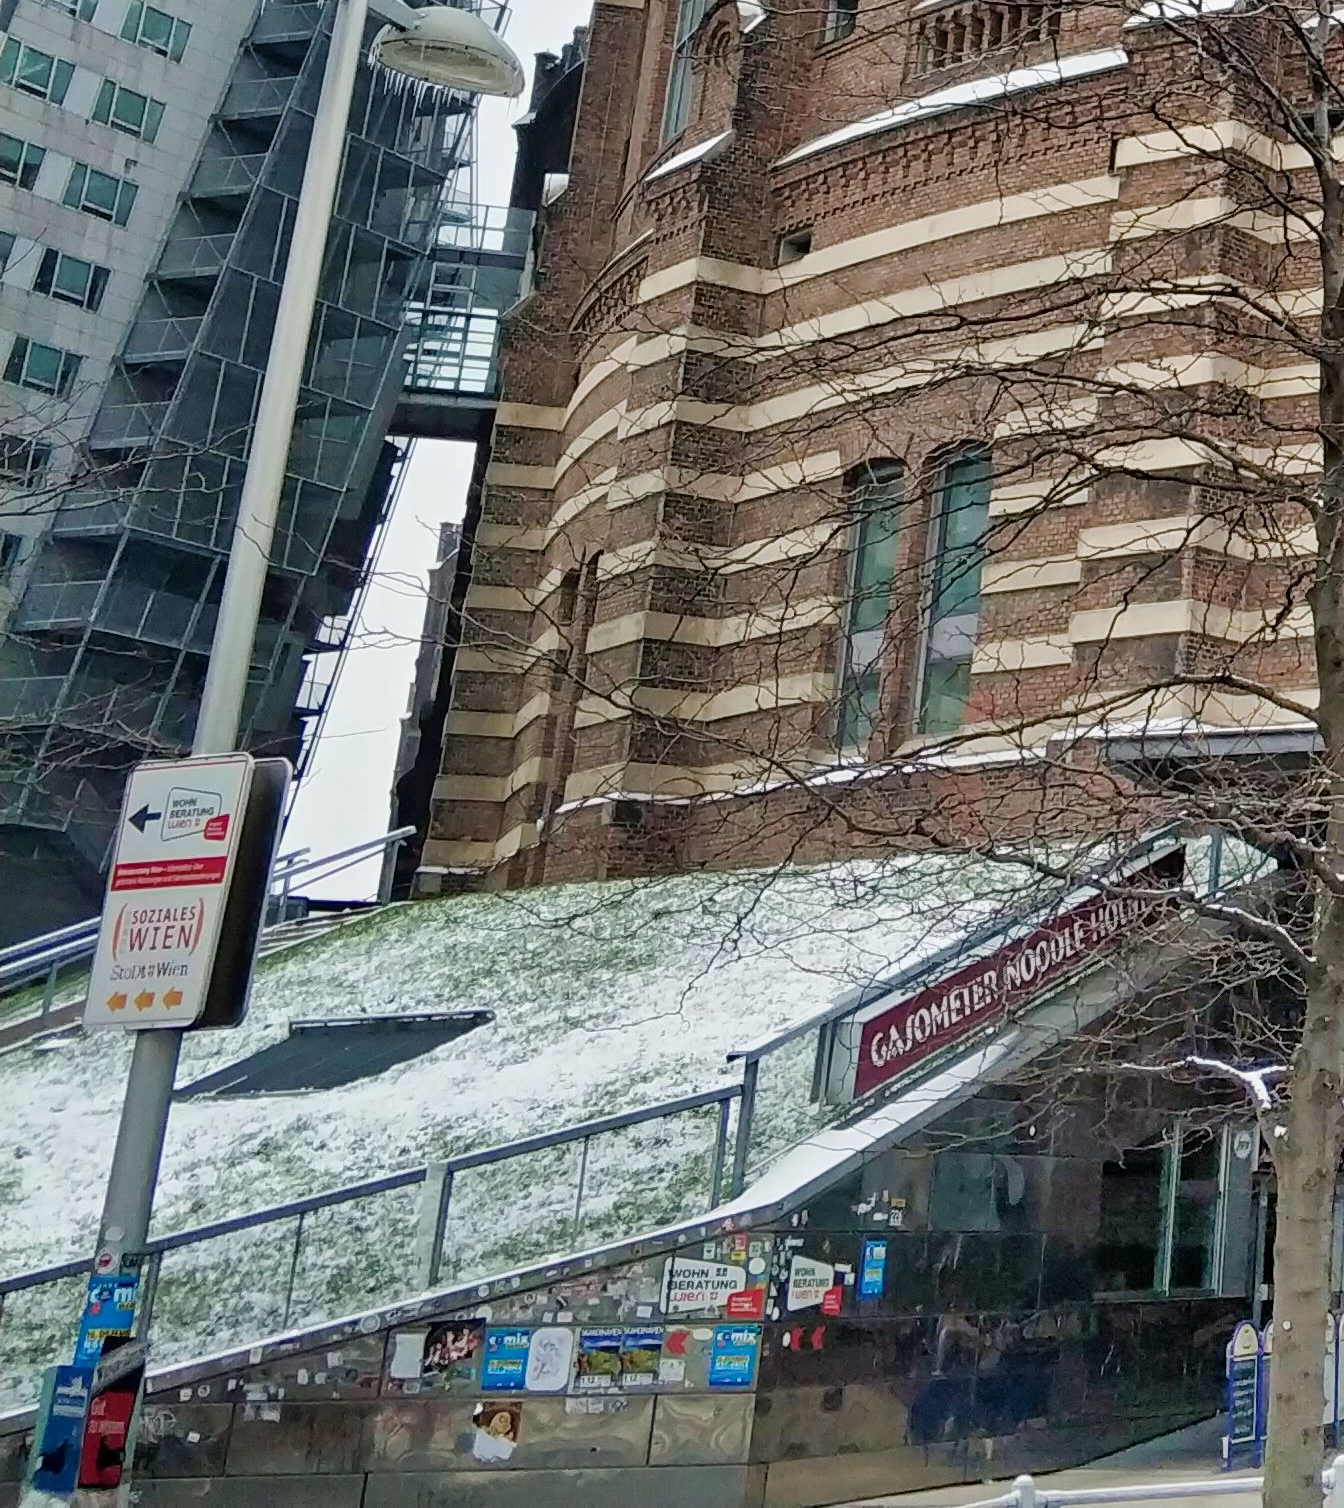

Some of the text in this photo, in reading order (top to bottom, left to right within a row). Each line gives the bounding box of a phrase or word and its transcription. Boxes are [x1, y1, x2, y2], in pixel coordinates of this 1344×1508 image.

[172, 798, 198, 808] WOHN
[170, 807, 215, 819] BERATUNG
[131, 906, 198, 925] SOZIALES
[129, 924, 194, 953] WIEN
[157, 959, 189, 977] Wien
[870, 970, 1000, 1068] GASOMETER
[668, 1268, 709, 1279] WOHN
[667, 1279, 738, 1291] BERATUNG
[793, 1278, 830, 1289] BERATUNG
